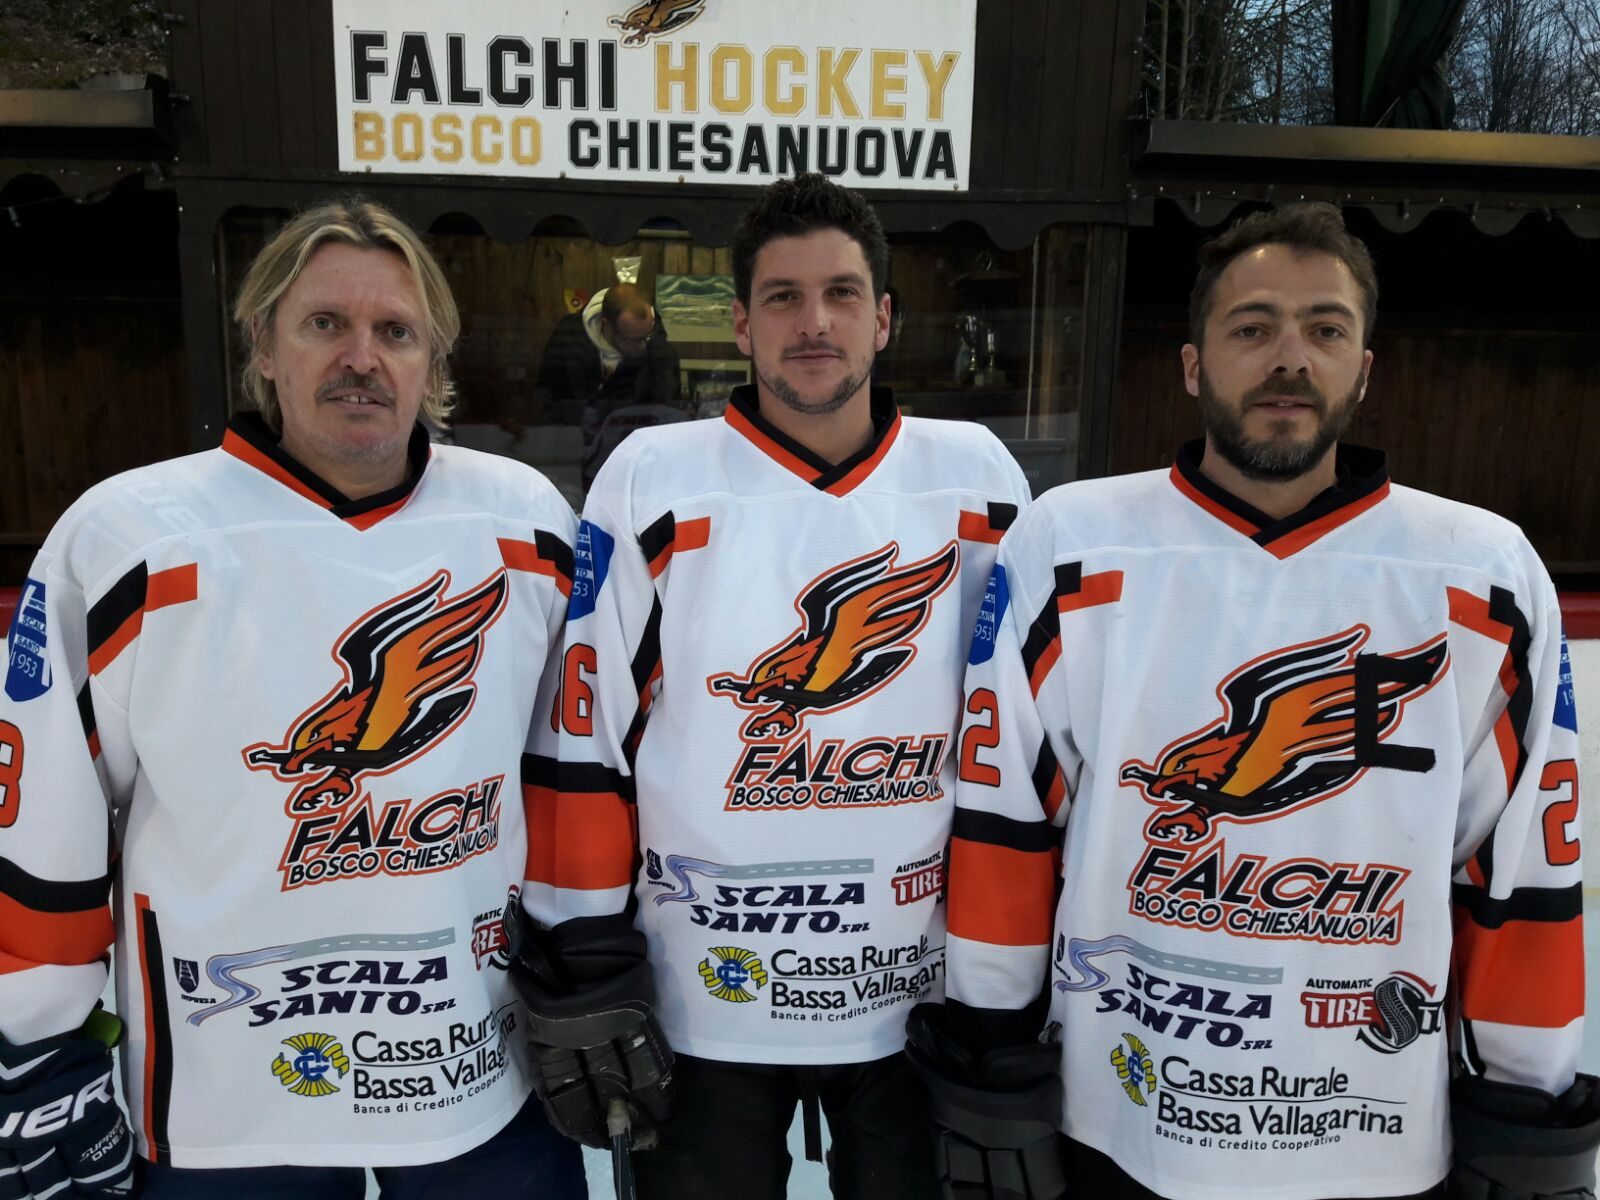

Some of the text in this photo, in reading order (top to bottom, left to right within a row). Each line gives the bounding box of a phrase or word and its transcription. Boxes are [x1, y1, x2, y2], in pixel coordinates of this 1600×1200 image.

[350, 30, 962, 122] FALCHI HOCKEY
[353, 110, 957, 180] BOSCO CHIESANUOVA
[22, 614, 46, 634] SCALA
[17, 634, 40, 655] SANTO
[11, 651, 38, 678] 1953
[733, 738, 944, 784] FALCHI
[731, 780, 942, 807] BOSCO CHIESANUOVA
[287, 780, 502, 864] FALCHI
[289, 822, 498, 885] BOSCO CHIESANUOVA
[896, 850, 941, 873] AUTOMATIC
[714, 882, 866, 908] SCALA
[895, 866, 943, 903] TIRE
[1133, 847, 1399, 914] FALCHI
[690, 904, 870, 934] SANTO SRL
[1134, 890, 1397, 940] BOSCO CHIESANUOVA
[281, 956, 448, 993] SCALA
[771, 949, 857, 978] Cassa
[771, 982, 847, 1010] Bassa
[1126, 963, 1273, 1020] SCALA
[1306, 977, 1373, 990] AUTOMATIC
[249, 990, 457, 1027] SANTO SRL
[771, 1010, 806, 1021] Banca
[812, 1010, 823, 1021] di
[827, 1006, 868, 1022] Credito
[1096, 989, 1273, 1050] SANTO SRL
[1305, 996, 1374, 1024] TIRE
[351, 1031, 444, 1063] Cassa
[353, 1069, 436, 1100] Bassa
[1160, 1055, 1349, 1098] Cassa Rurale
[353, 1104, 391, 1115] Banca
[396, 1102, 409, 1114] di
[414, 1094, 464, 1113] Credito
[1157, 1089, 1404, 1138] Bassa Vallagarina
[1156, 1125, 1341, 1151] Banca di Credito Cooperativo
